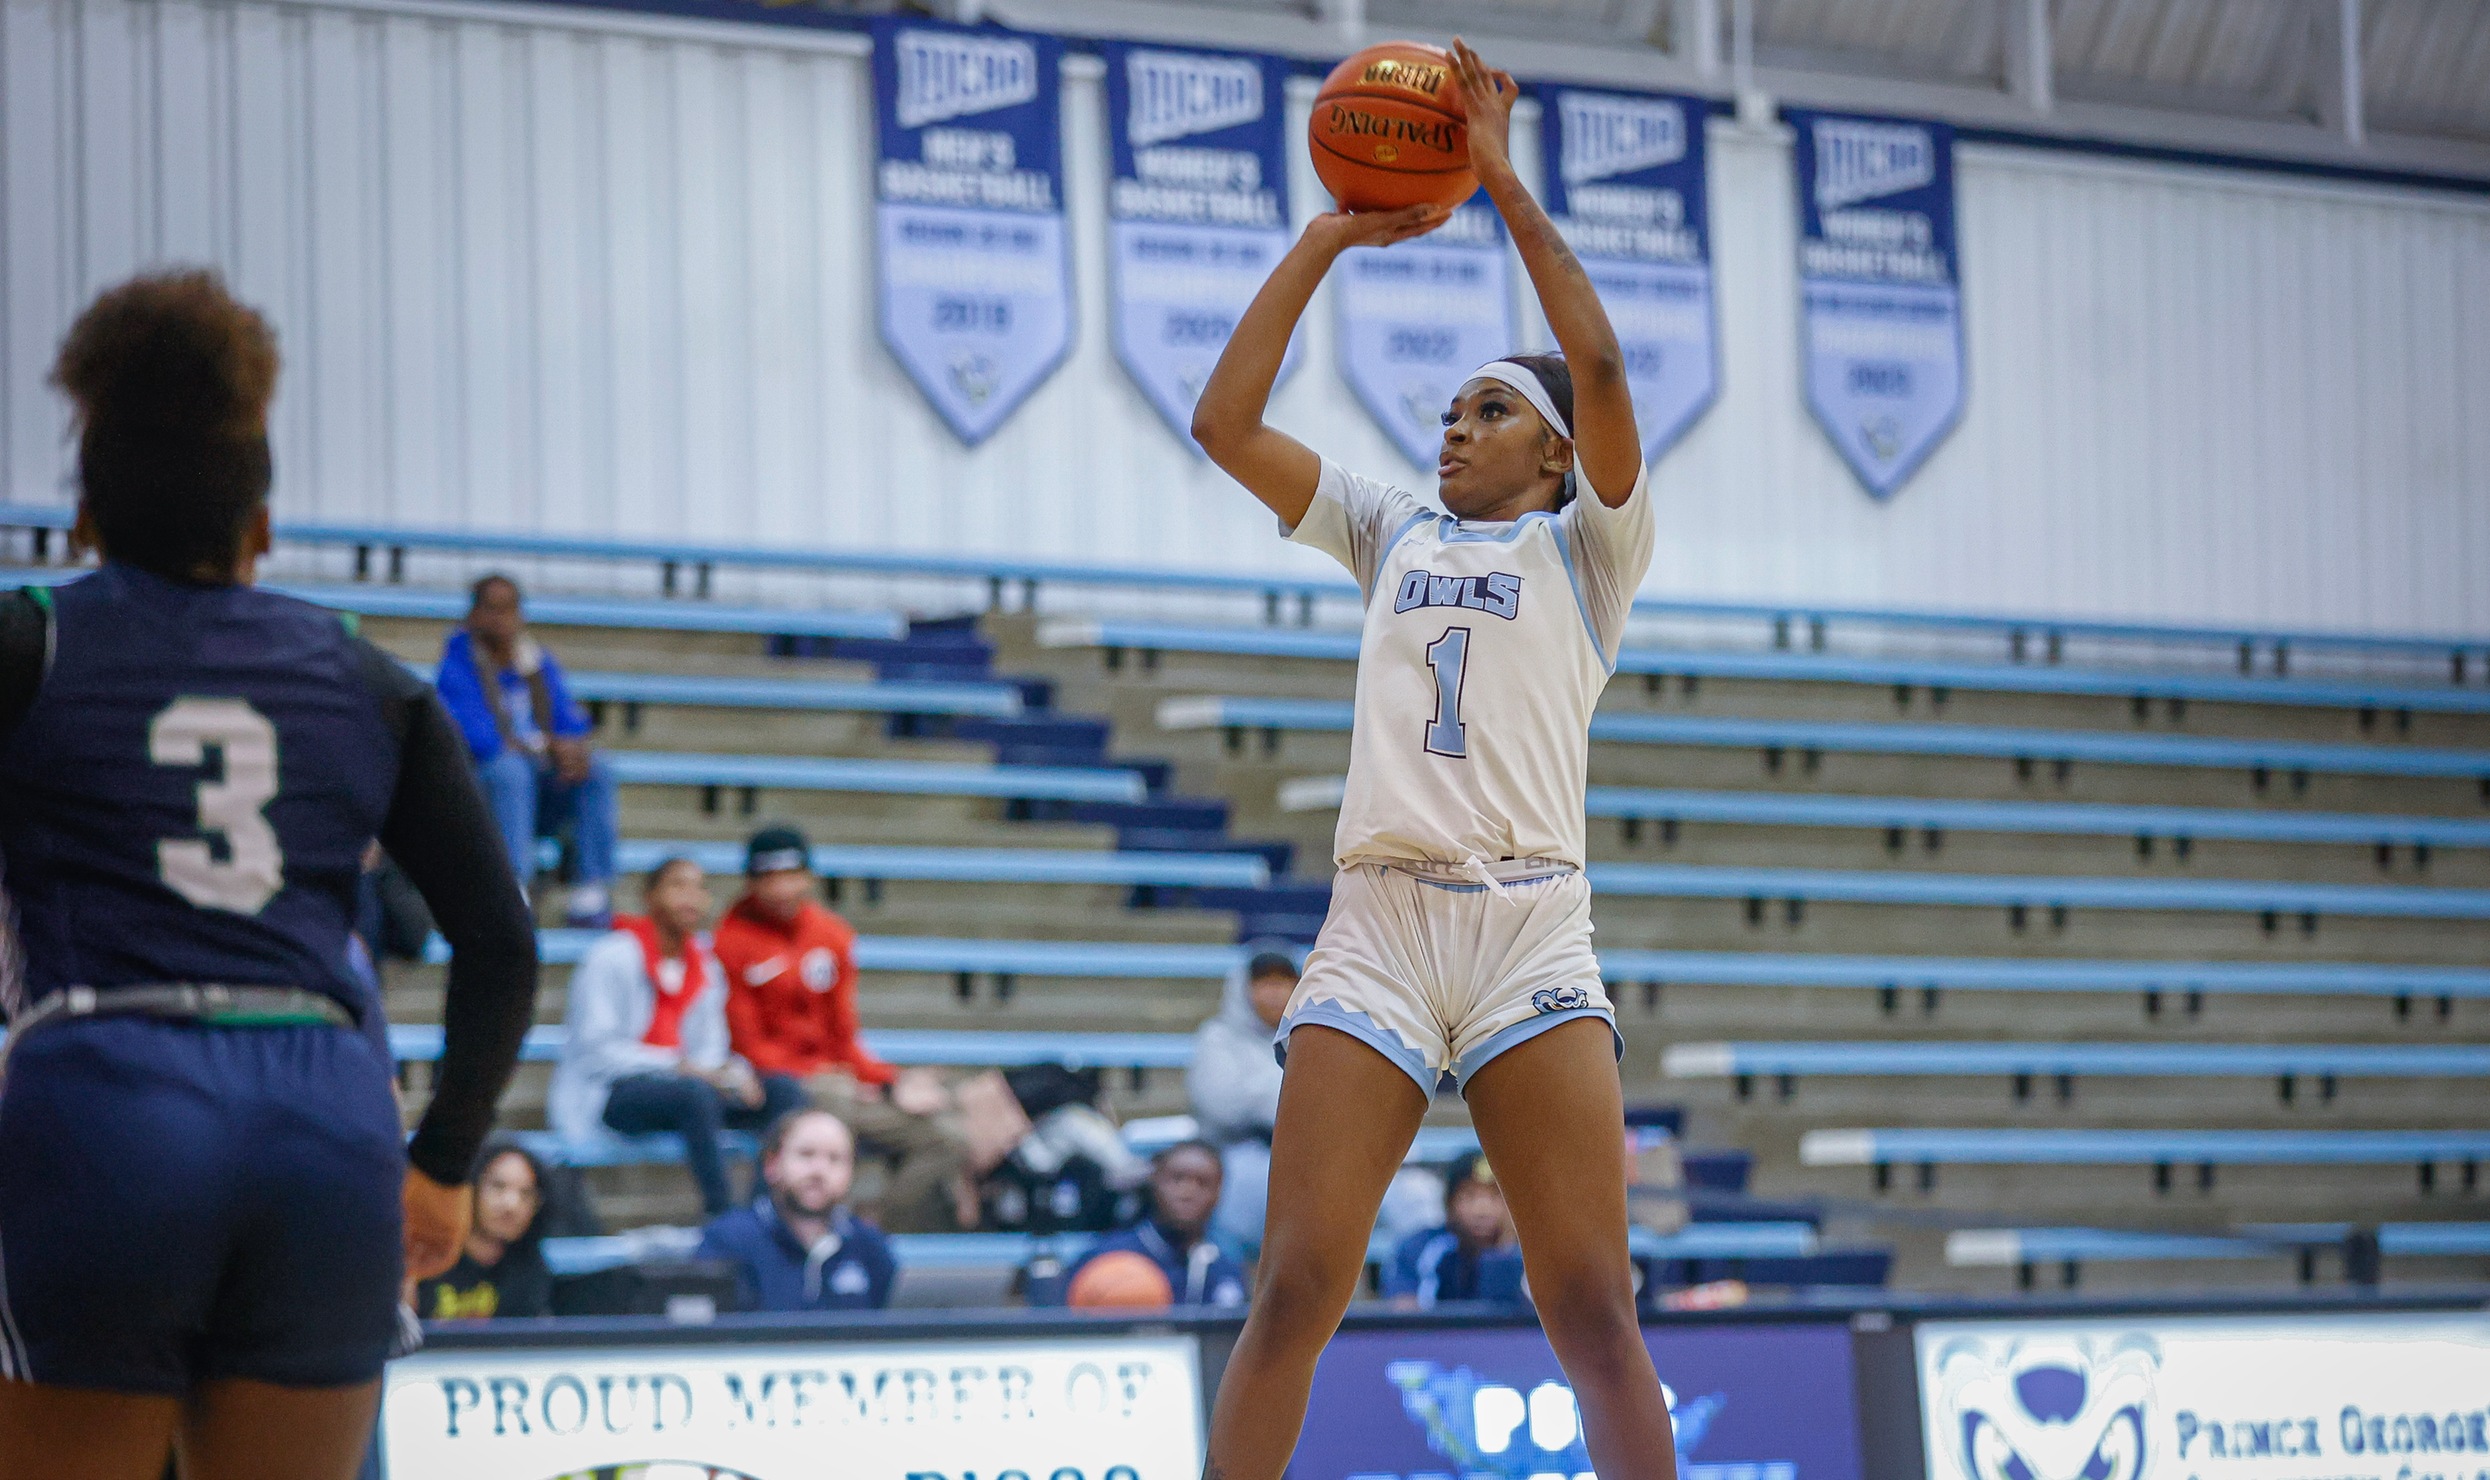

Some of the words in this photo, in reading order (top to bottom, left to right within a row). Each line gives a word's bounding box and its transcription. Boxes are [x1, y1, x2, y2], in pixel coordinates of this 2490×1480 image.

[1329, 103, 1460, 153] SPALDING
[881, 163, 1053, 210] BASKETBALL
[1107, 181, 1281, 226] BASKETBALL
[1394, 569, 1521, 621] OWLS
[1424, 626, 1471, 759] 1
[147, 695, 286, 917] 3
[438, 1373, 694, 1437] PROUD
[724, 1364, 1036, 1430] MEMBER
[1065, 1361, 1153, 1420] OF
